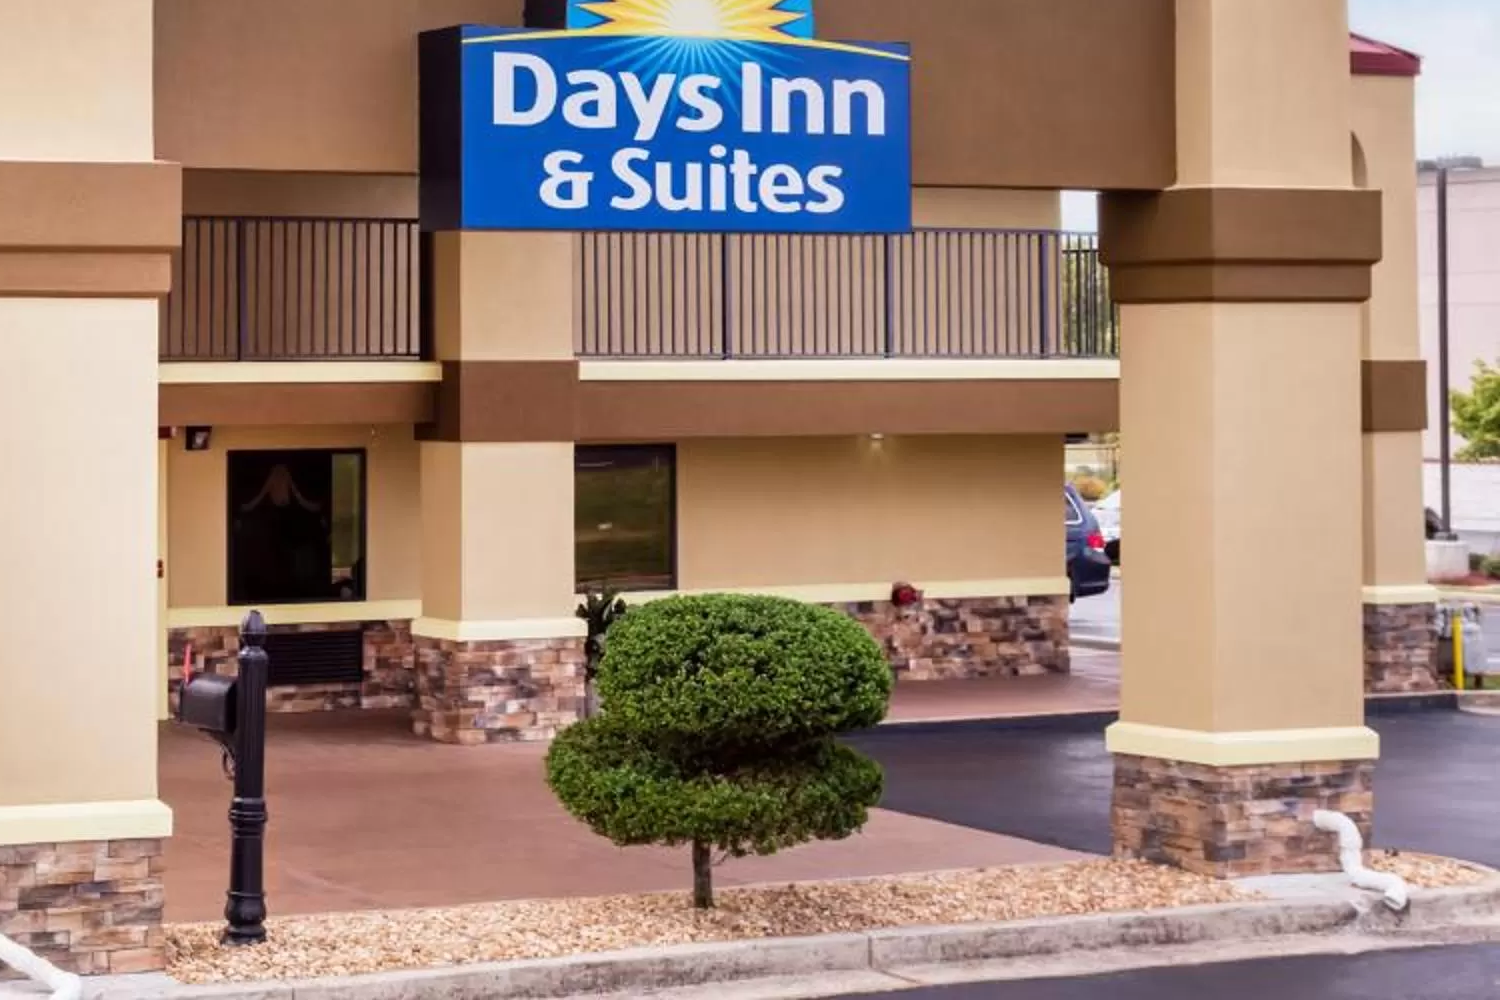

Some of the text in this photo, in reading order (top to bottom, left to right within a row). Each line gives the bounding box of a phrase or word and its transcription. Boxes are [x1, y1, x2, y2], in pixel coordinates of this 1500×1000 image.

[492, 50, 885, 141] Days Inn
[538, 144, 845, 214] & Suites
